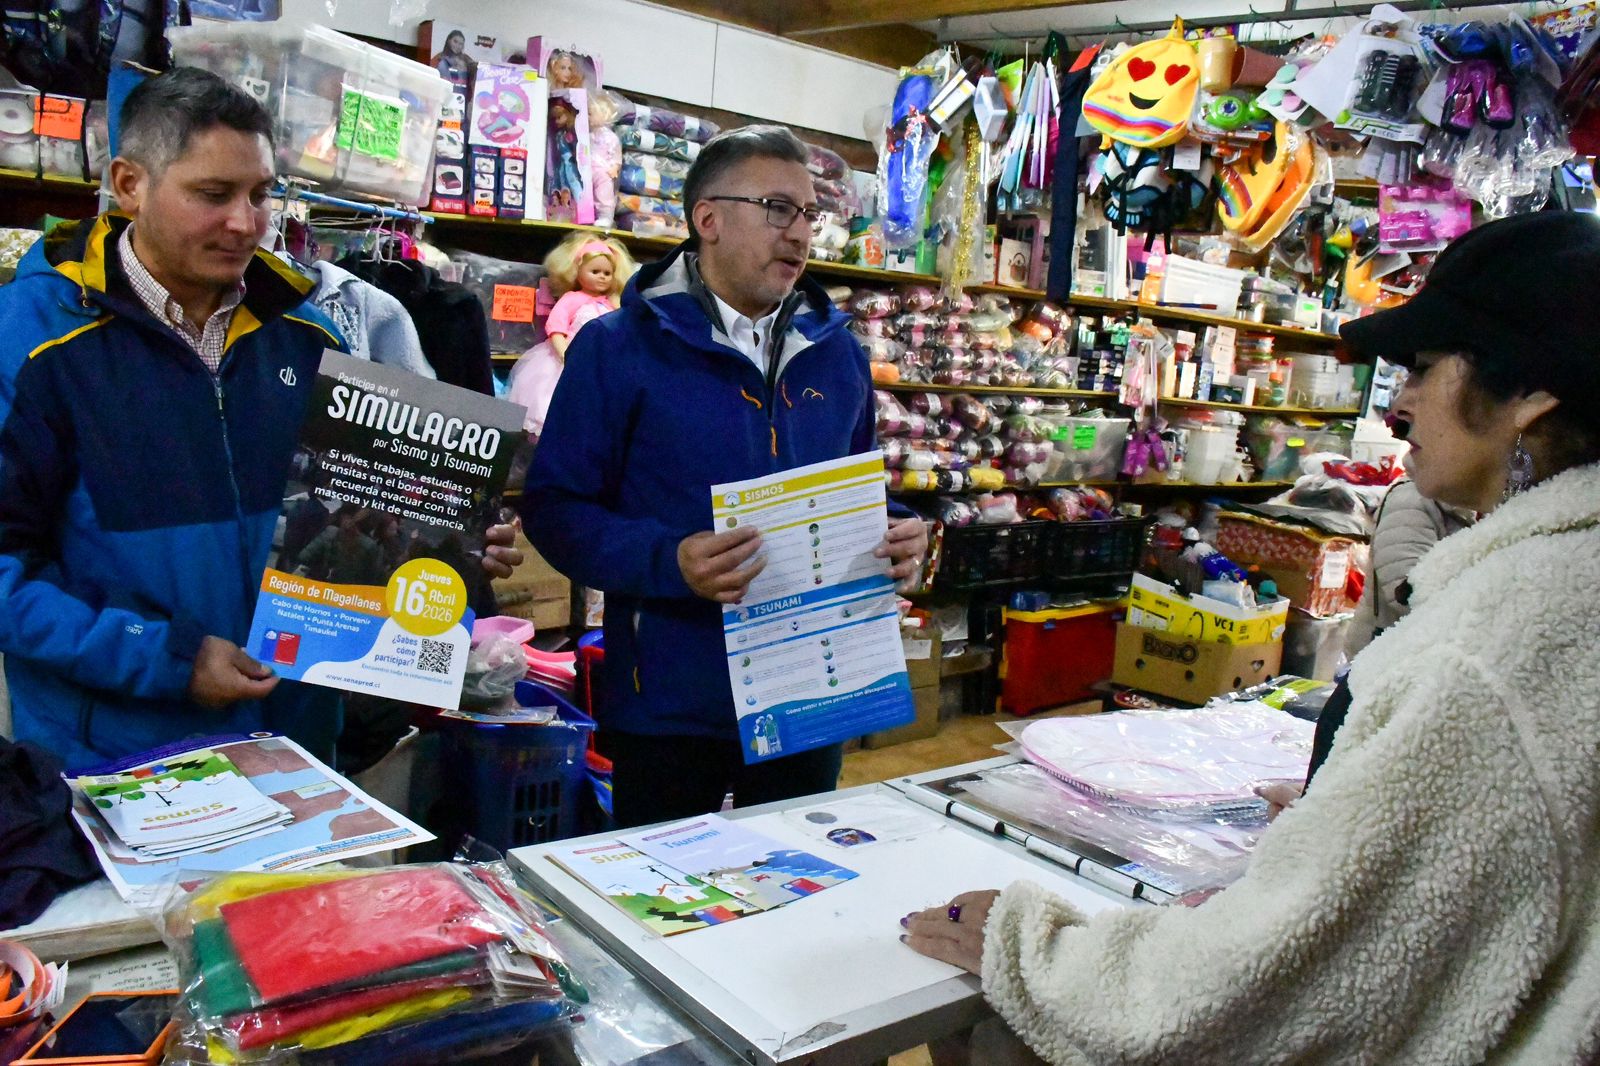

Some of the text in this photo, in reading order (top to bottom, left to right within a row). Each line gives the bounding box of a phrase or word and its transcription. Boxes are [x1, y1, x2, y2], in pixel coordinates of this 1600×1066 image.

[338, 372, 400, 398] Participa en el
[327, 385, 501, 460] SIMULACRO
[372, 437, 493, 479] por Sismo y Tsunami
[329, 448, 472, 495] Si vives, trabajas, estudias o
[321, 460, 472, 509] transitas en el borde costero,
[745, 484, 784, 502] SISMOS
[330, 476, 458, 516] recuerda evacuar con tu
[314, 486, 466, 532] mascota y kit de emergencia.
[417, 569, 452, 585] Jueves
[269, 576, 382, 612] Región de Magallanes
[394, 576, 427, 616] 16
[428, 589, 456, 606] Abril
[272, 598, 371, 626] Cabo de Hornos Porvenir
[423, 604, 452, 622] 2026
[754, 596, 802, 616] TSUNAMI
[277, 608, 360, 632] Natales Punta Arenas
[304, 624, 338, 638] Timaukel
[392, 634, 418, 646] ¿Sabes
[374, 653, 415, 667] participar?
[144, 802, 224, 823] Sismos
[659, 830, 721, 849] Tsunami
[590, 851, 642, 864] Sism
